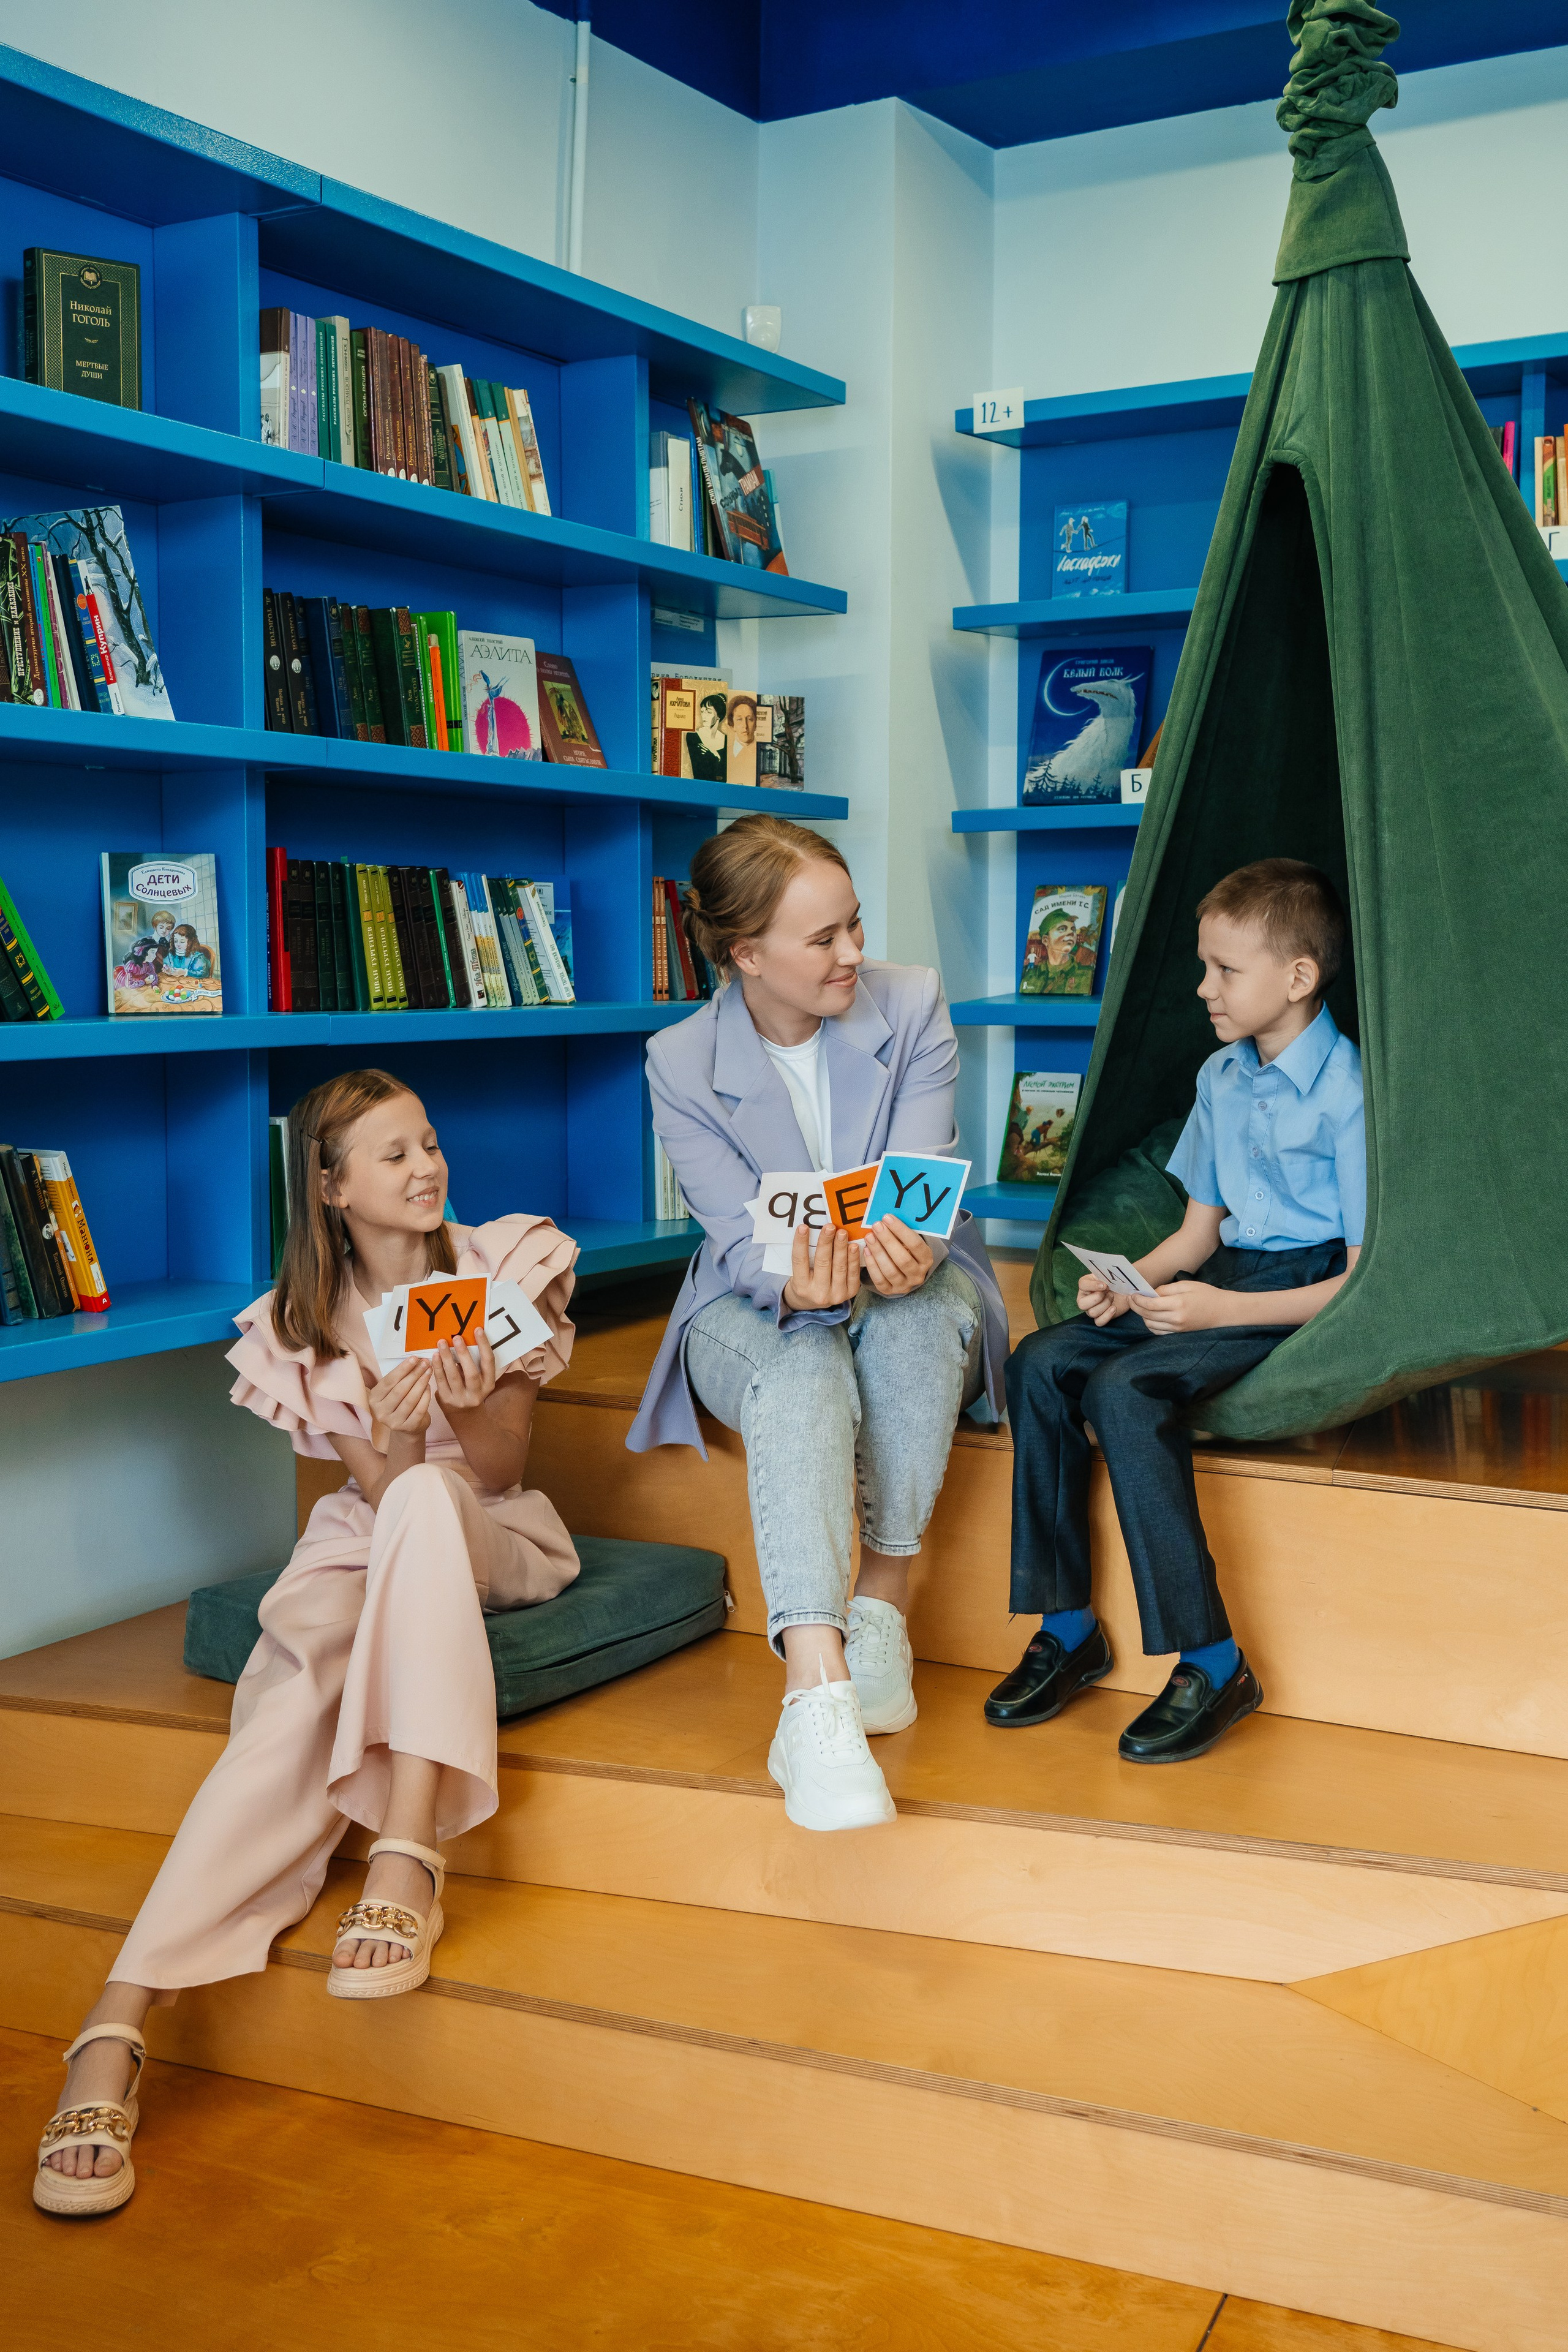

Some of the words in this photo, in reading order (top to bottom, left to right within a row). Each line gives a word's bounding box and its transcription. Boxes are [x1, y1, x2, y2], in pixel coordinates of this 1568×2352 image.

[70, 301, 112, 315] Николай
[72, 314, 110, 328] ГОГОЛЬ
[76, 360, 108, 370] МЕРТВЫЕ
[697, 435, 712, 488] МАНДЕЛЬШТАМ
[20, 563, 27, 577] XX
[7, 581, 17, 618] НАКАЗАНИЕ
[265, 595, 271, 605] Л.
[92, 614, 107, 654] Куприн
[266, 608, 276, 647] ТОЛСТОЙ
[288, 612, 297, 650] ТОЛСТОЙ
[13, 627, 24, 676] ПРЕСТУПЛЕНИЕ
[31, 636, 40, 680] Драматургия
[104, 654, 113, 680] Александр
[456, 643, 467, 679] АЭЛИТА
[470, 644, 532, 664] АЭЛИТА
[1063, 667, 1095, 677] БЕЛЫЙ
[1099, 666, 1123, 677] ВОЛК
[410, 677, 421, 714] ТОЛСТОЙ
[1131, 774, 1142, 792] Б
[136, 883, 192, 898] Солнцевых
[147, 875, 179, 886] ДЕТИ
[1035, 905, 1049, 914] САД
[368, 925, 377, 967] ТУРГЕНЕВ
[380, 926, 390, 967] ТУРГЕНЕВ
[392, 927, 401, 968] ТУРГЕНЕВ
[552, 951, 562, 970] АФАНАСИЙ
[508, 962, 519, 992] Афанасий
[34, 1178, 45, 1210] ПУШКИН
[835, 1182, 869, 1226] E
[889, 1169, 952, 1223] Yy
[77, 1218, 95, 1264] Манюня
[53, 1252, 62, 1275] Евгений
[59, 1276, 69, 1298] Онегин
[415, 1294, 478, 1339] Yy
